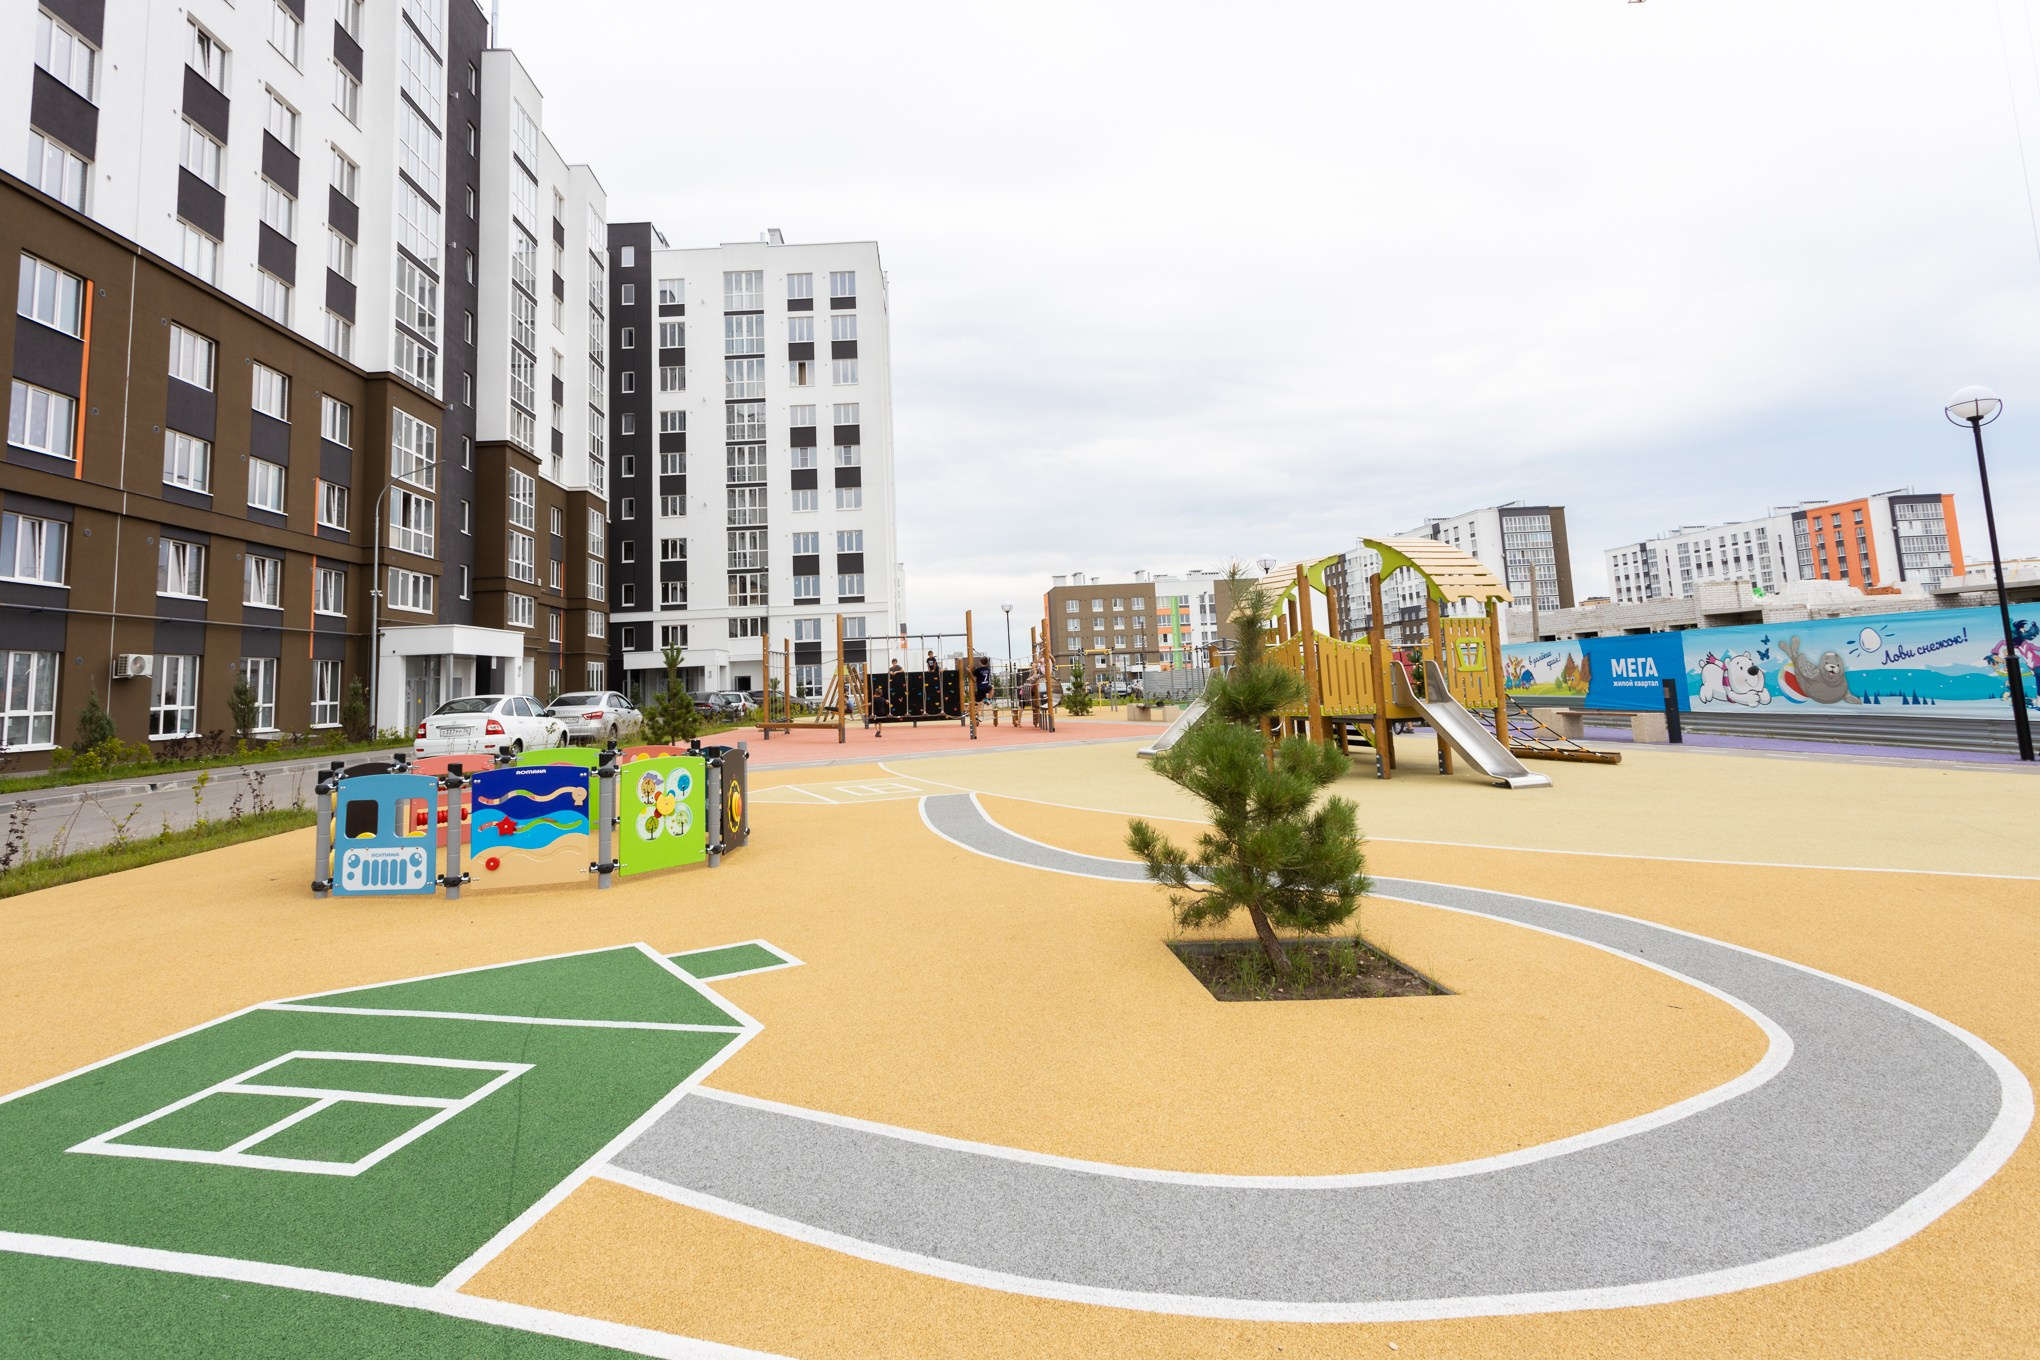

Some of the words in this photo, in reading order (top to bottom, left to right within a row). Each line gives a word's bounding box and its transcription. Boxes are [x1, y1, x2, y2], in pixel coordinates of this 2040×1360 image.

[1881, 644, 1916, 666] Лови
[1916, 626, 1969, 655] снежок!
[1610, 656, 1659, 678] МЕГА
[1612, 679, 1634, 687] жилой
[1634, 680, 1659, 689] квартал
[515, 768, 547, 776] ROMANA
